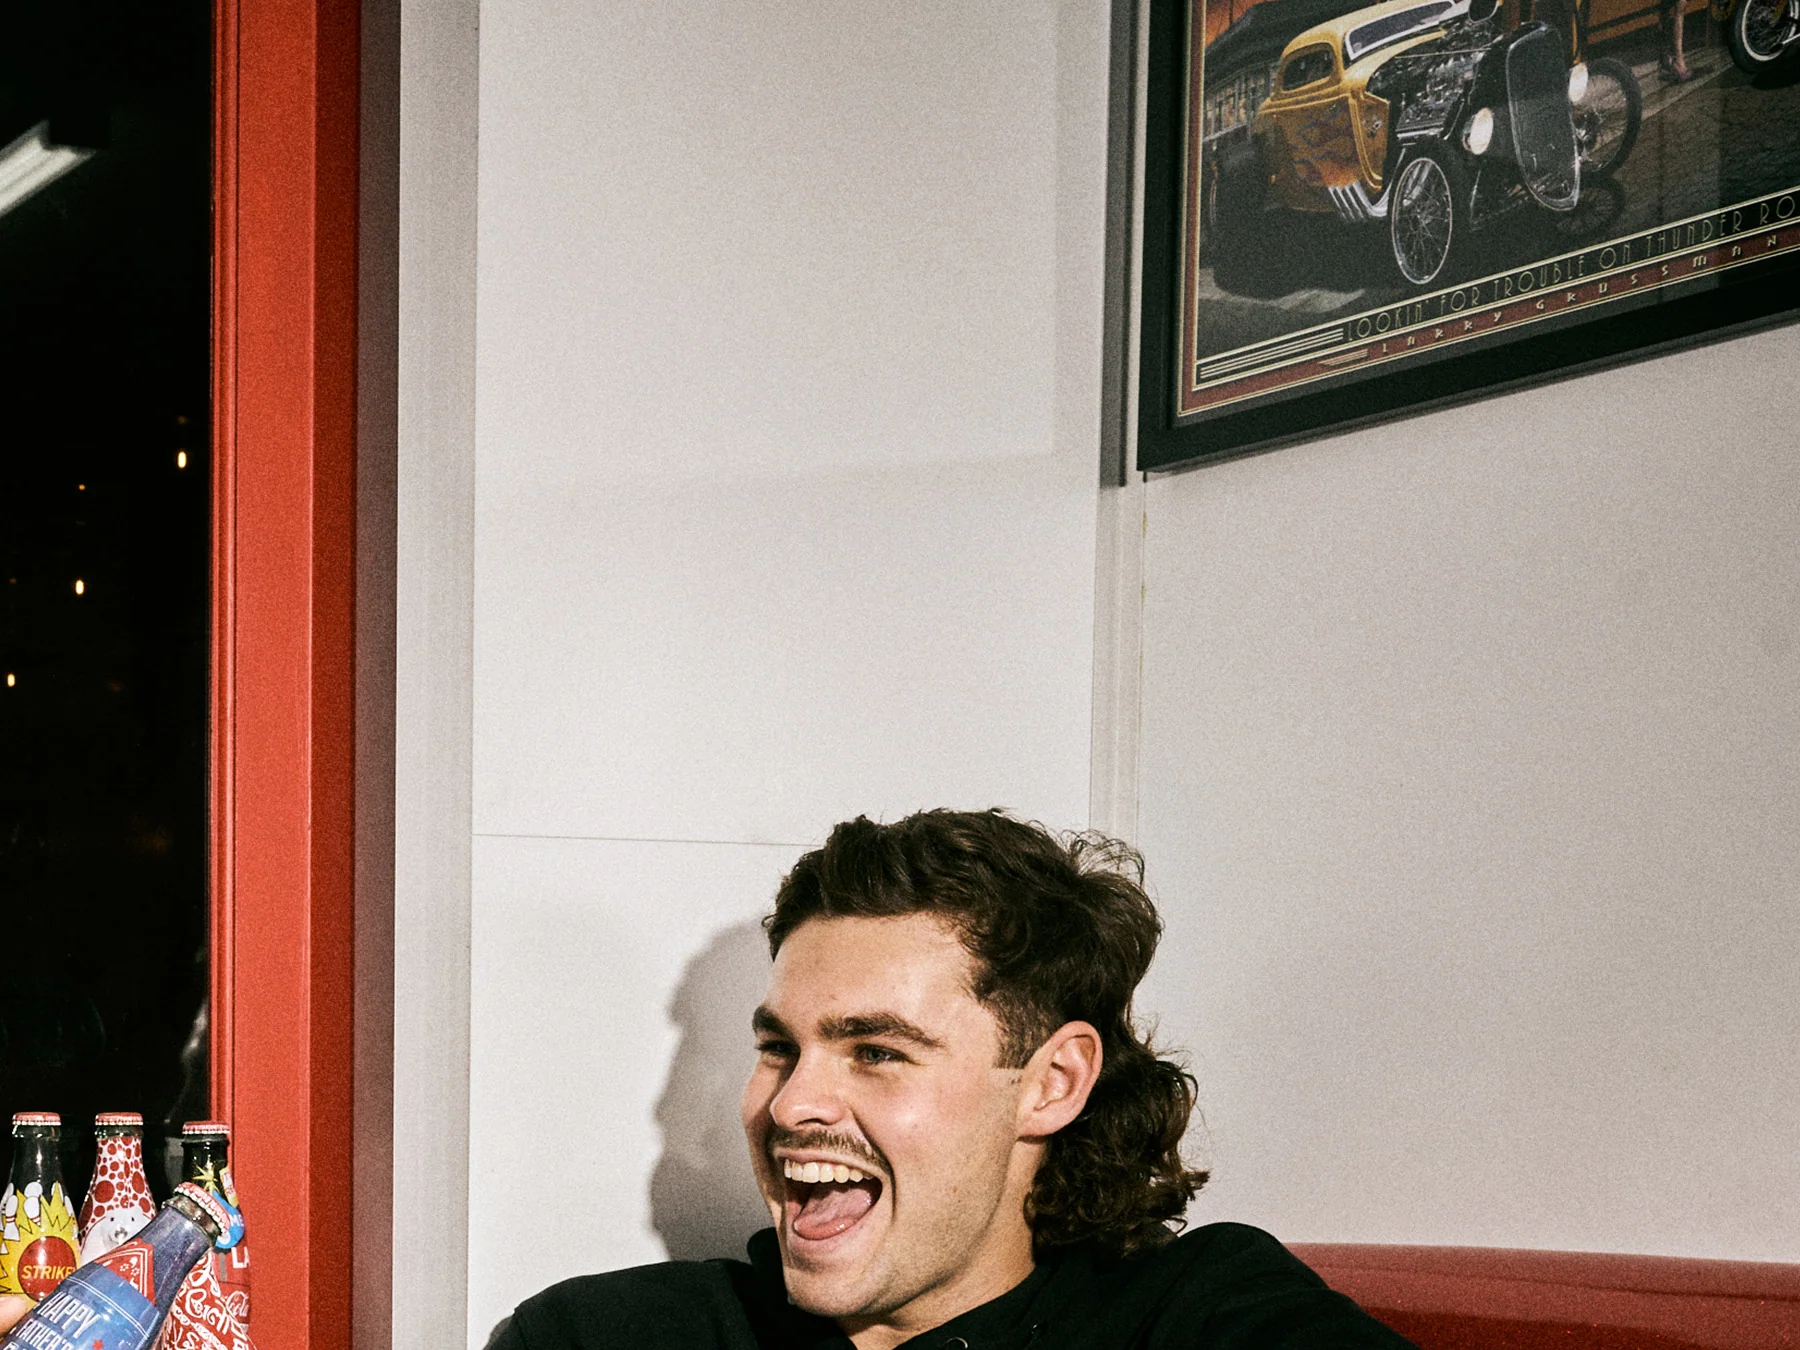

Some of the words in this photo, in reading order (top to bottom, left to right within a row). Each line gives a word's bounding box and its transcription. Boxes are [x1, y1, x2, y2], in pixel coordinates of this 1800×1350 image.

[1348, 299, 1430, 342] LOOKIN'
[1439, 285, 1480, 316] FOR
[1493, 255, 1585, 302] TROUBLE
[1599, 244, 1631, 270] ON
[1645, 210, 1743, 259] THUNDER
[1759, 194, 1797, 226] RO
[1381, 311, 1502, 353] LARRY
[1535, 234, 1778, 310] GROSSMAN
[36, 1291, 102, 1339] HAPPY
